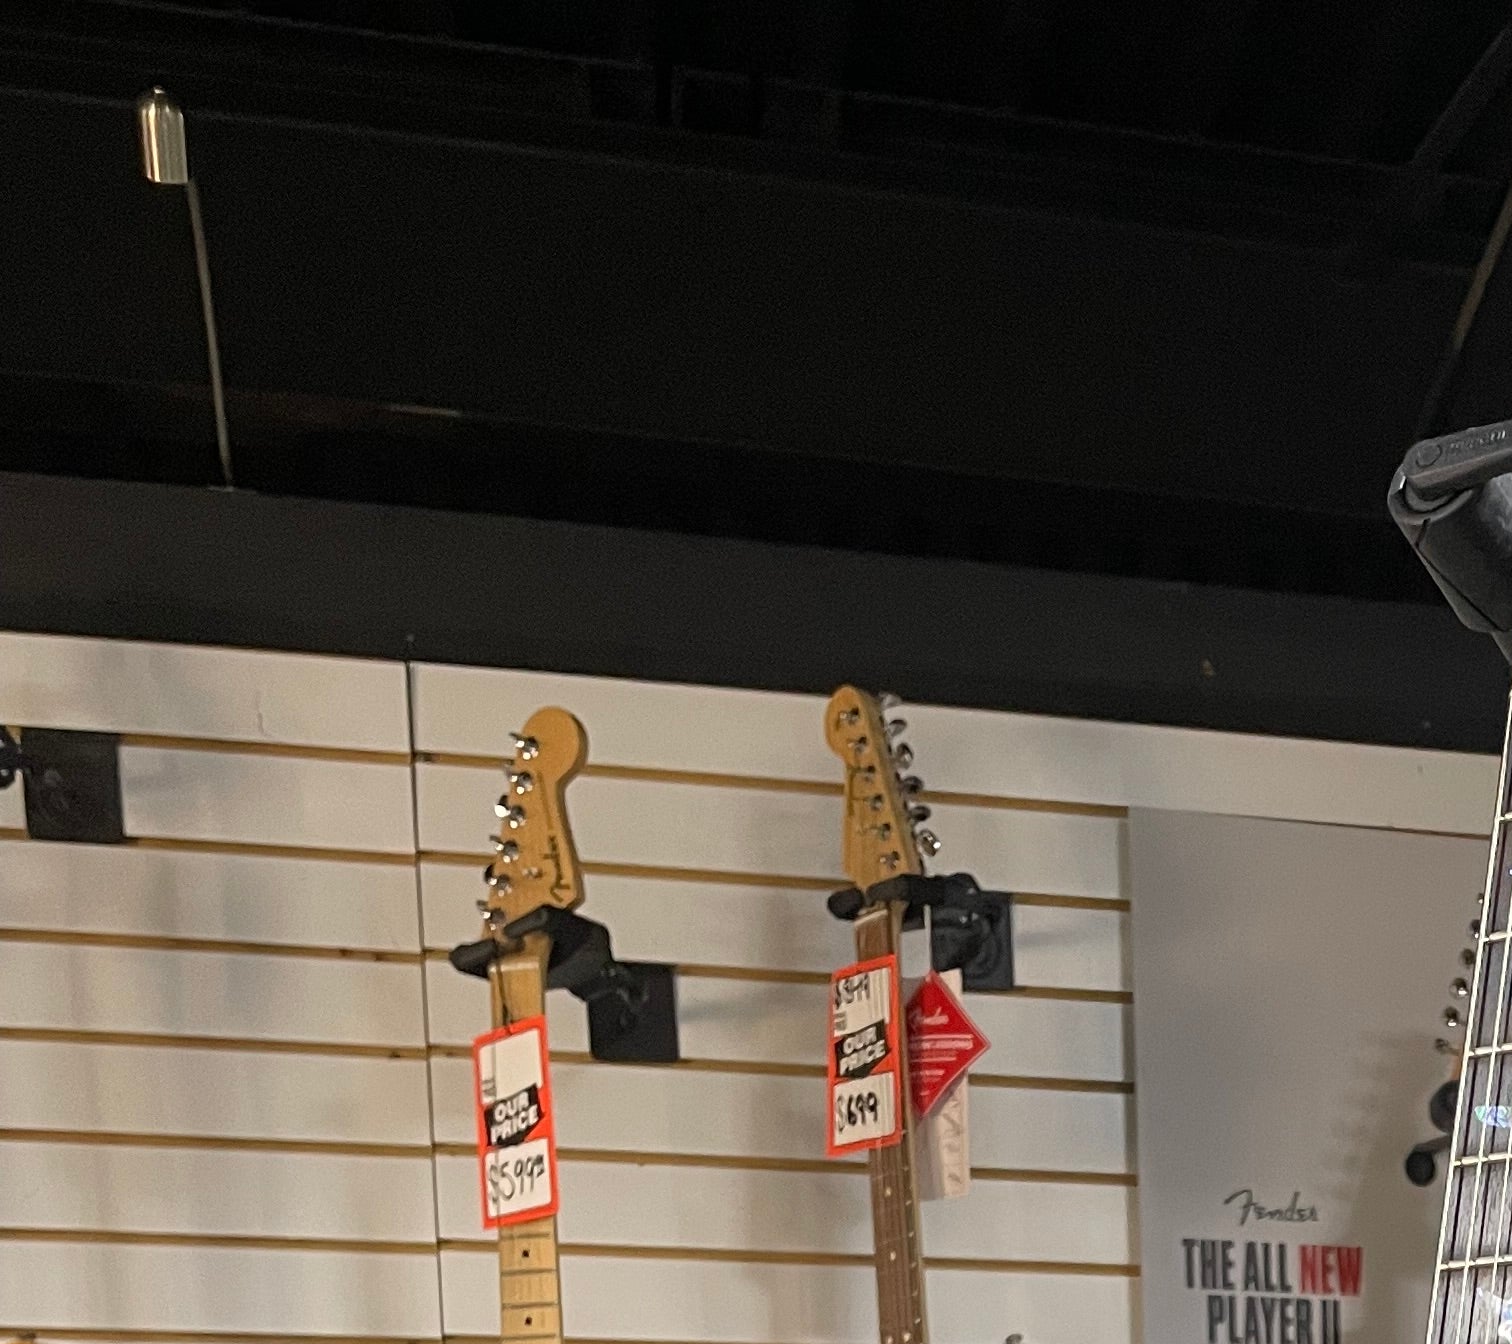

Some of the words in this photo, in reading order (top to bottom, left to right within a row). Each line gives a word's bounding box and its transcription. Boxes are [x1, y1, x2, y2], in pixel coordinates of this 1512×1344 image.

[490, 1106, 540, 1143] PRICE
[494, 1091, 530, 1121] OUR
[1224, 1189, 1319, 1226] Fender
[1183, 1239, 1235, 1290] THE
[1243, 1242, 1292, 1292] ALL
[1300, 1244, 1364, 1297] NEW
